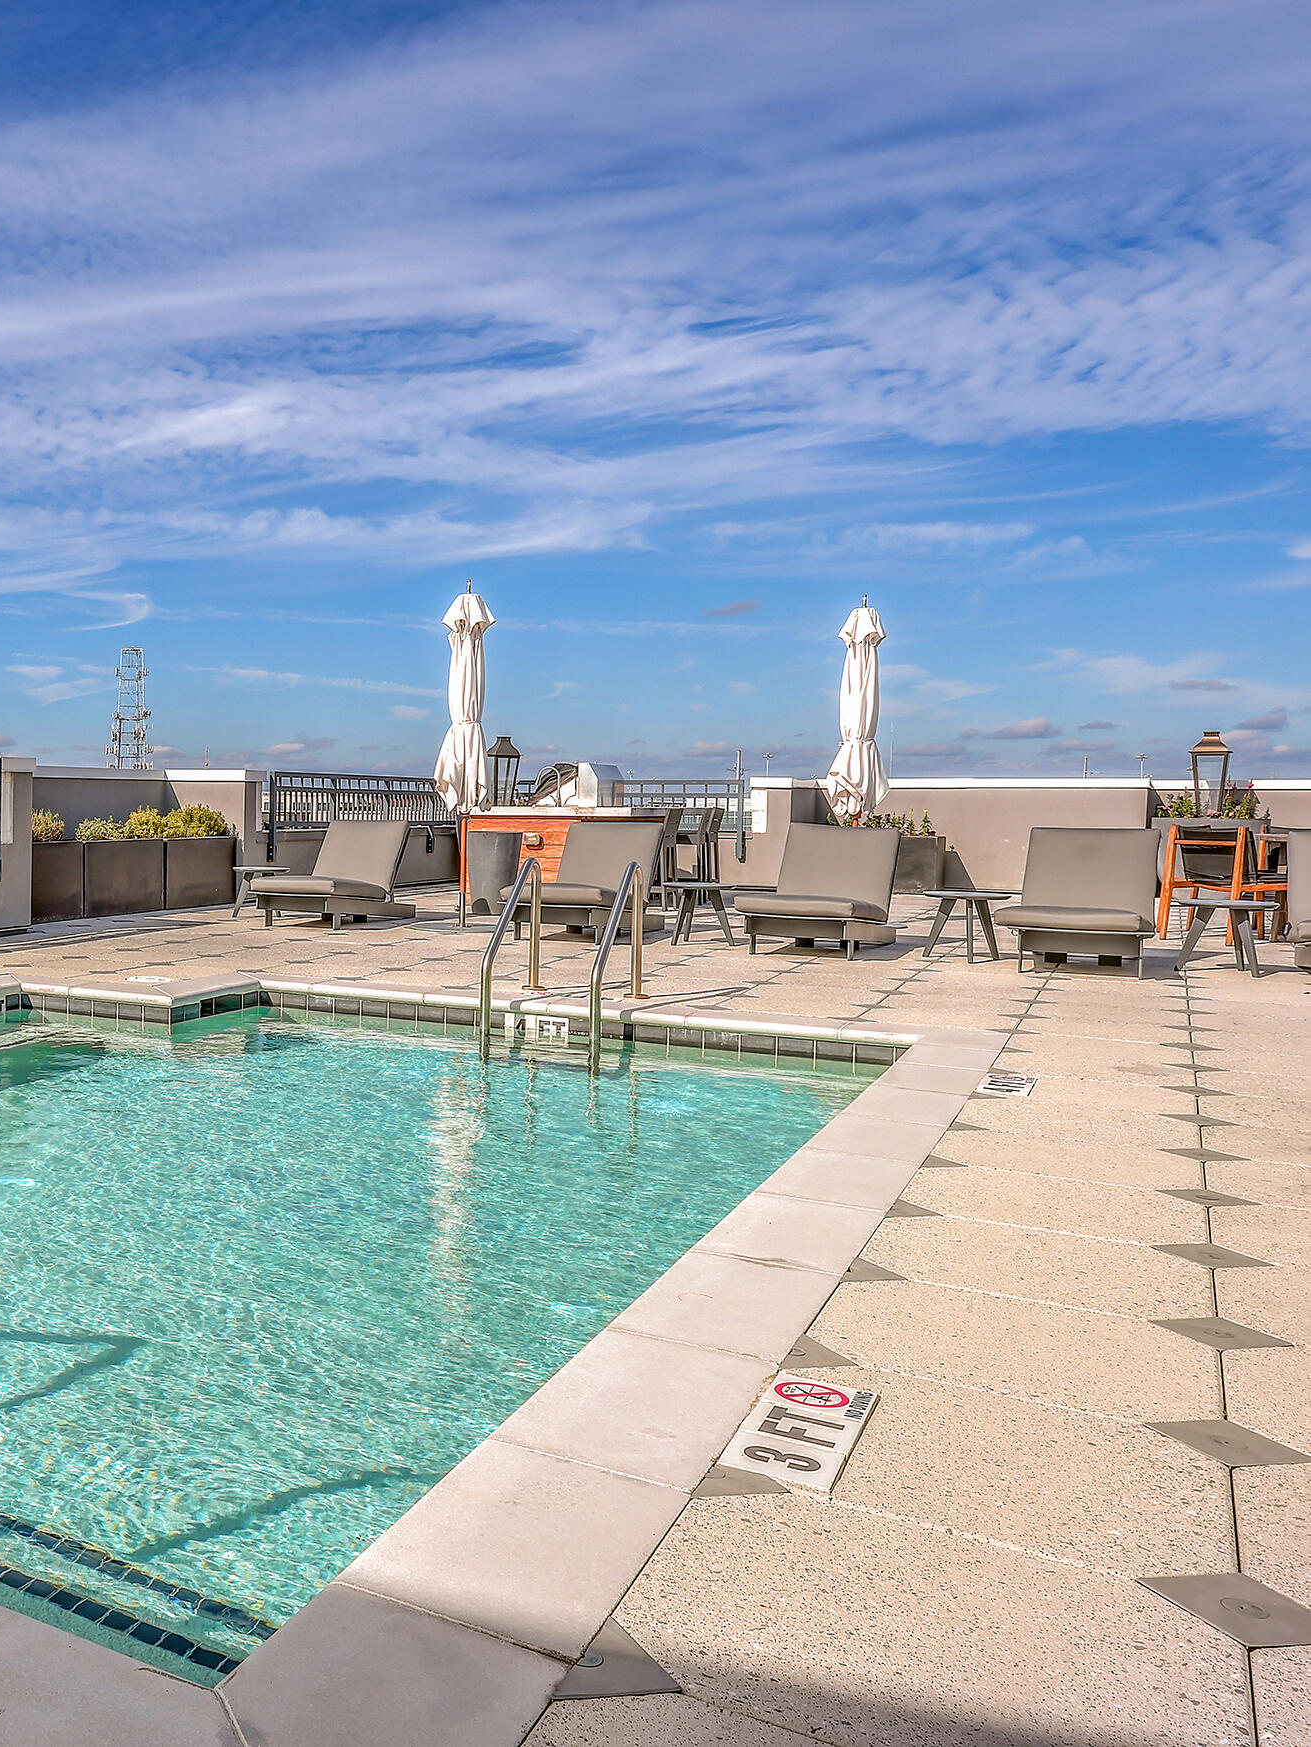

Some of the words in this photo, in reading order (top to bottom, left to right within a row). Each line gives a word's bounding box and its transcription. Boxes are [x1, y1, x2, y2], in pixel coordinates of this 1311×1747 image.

[538, 1020, 566, 1034] FT
[848, 1390, 874, 1411] DIVING
[843, 1409, 865, 1420] NO
[757, 1405, 846, 1449] FT
[743, 1445, 822, 1472] 3
